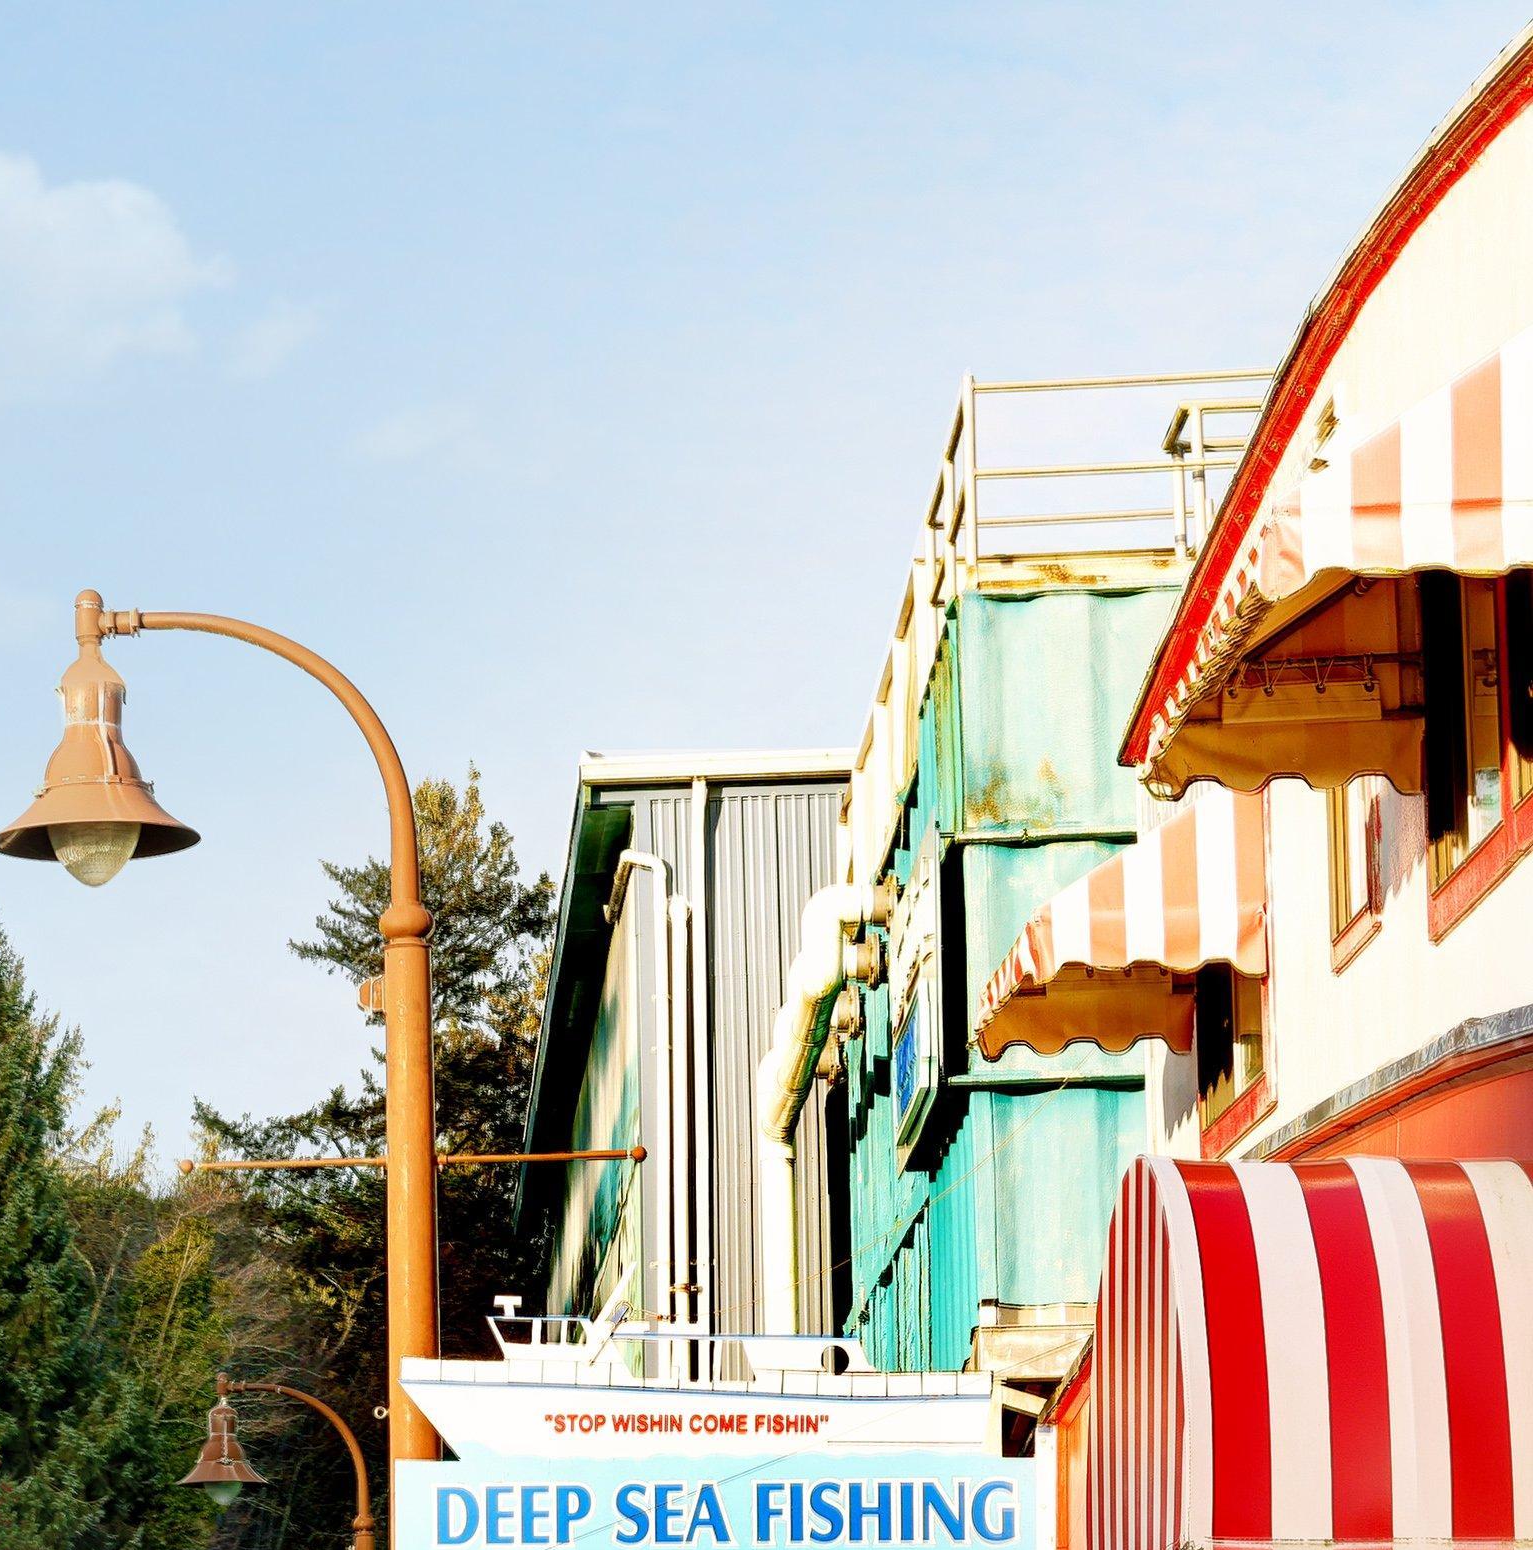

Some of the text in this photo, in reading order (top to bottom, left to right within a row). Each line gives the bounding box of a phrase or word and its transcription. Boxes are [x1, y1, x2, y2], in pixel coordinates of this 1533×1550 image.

[544, 1413, 829, 1434] "STOP WISHIN COME FISHIN"
[435, 1481, 1017, 1546] DEEP SEA FISHING
